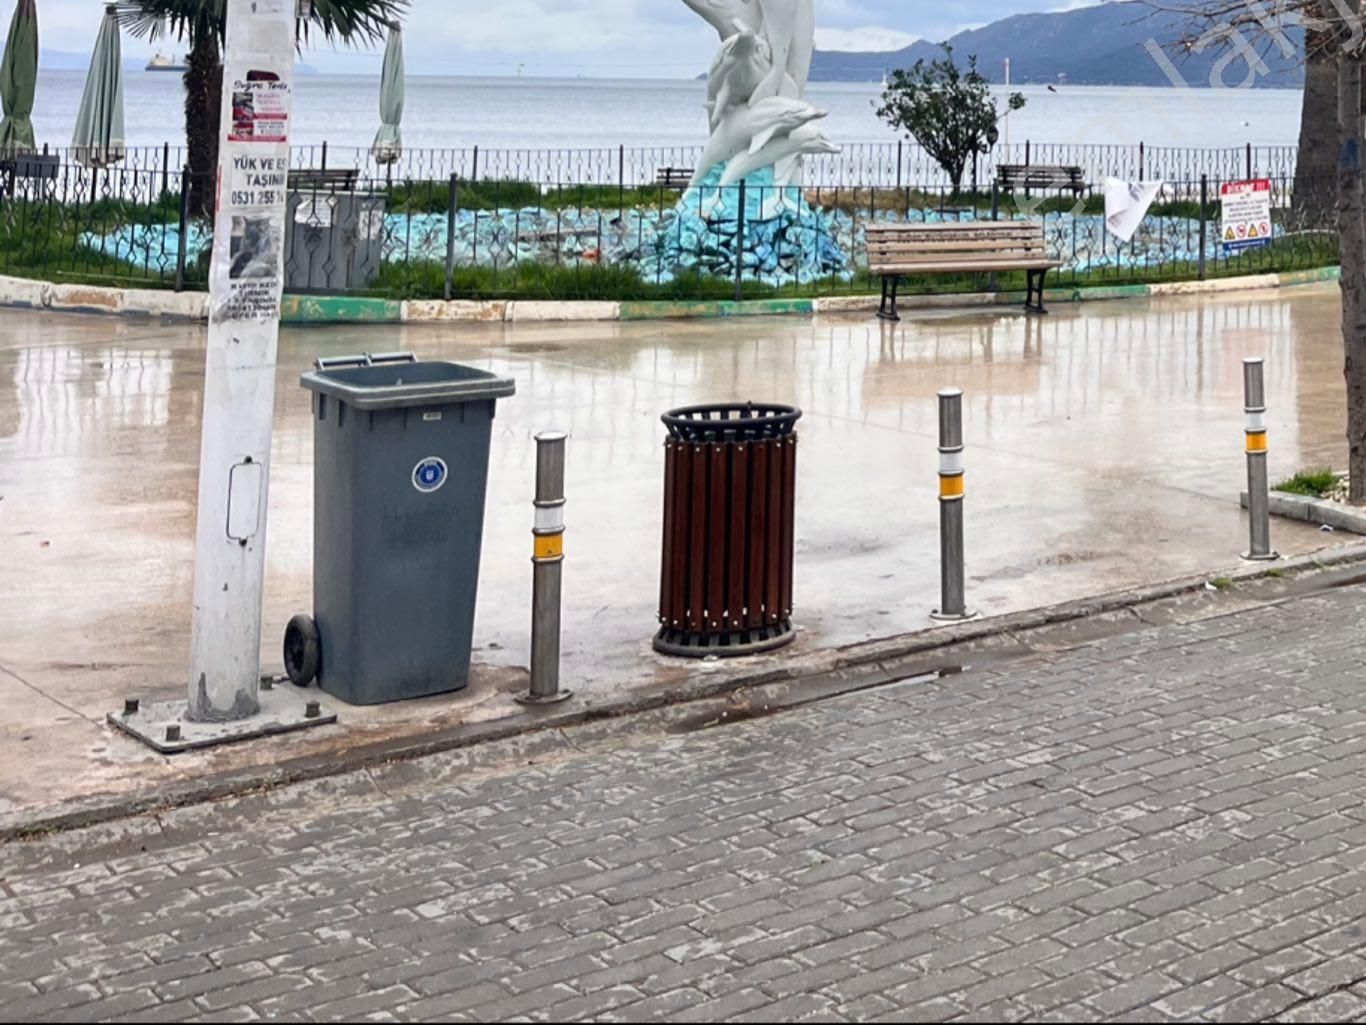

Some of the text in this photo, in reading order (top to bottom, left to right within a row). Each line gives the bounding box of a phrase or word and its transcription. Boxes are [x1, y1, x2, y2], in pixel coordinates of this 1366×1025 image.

[233, 154, 256, 170] YÜK
[260, 158, 274, 170] VE
[231, 190, 255, 205] 0531
